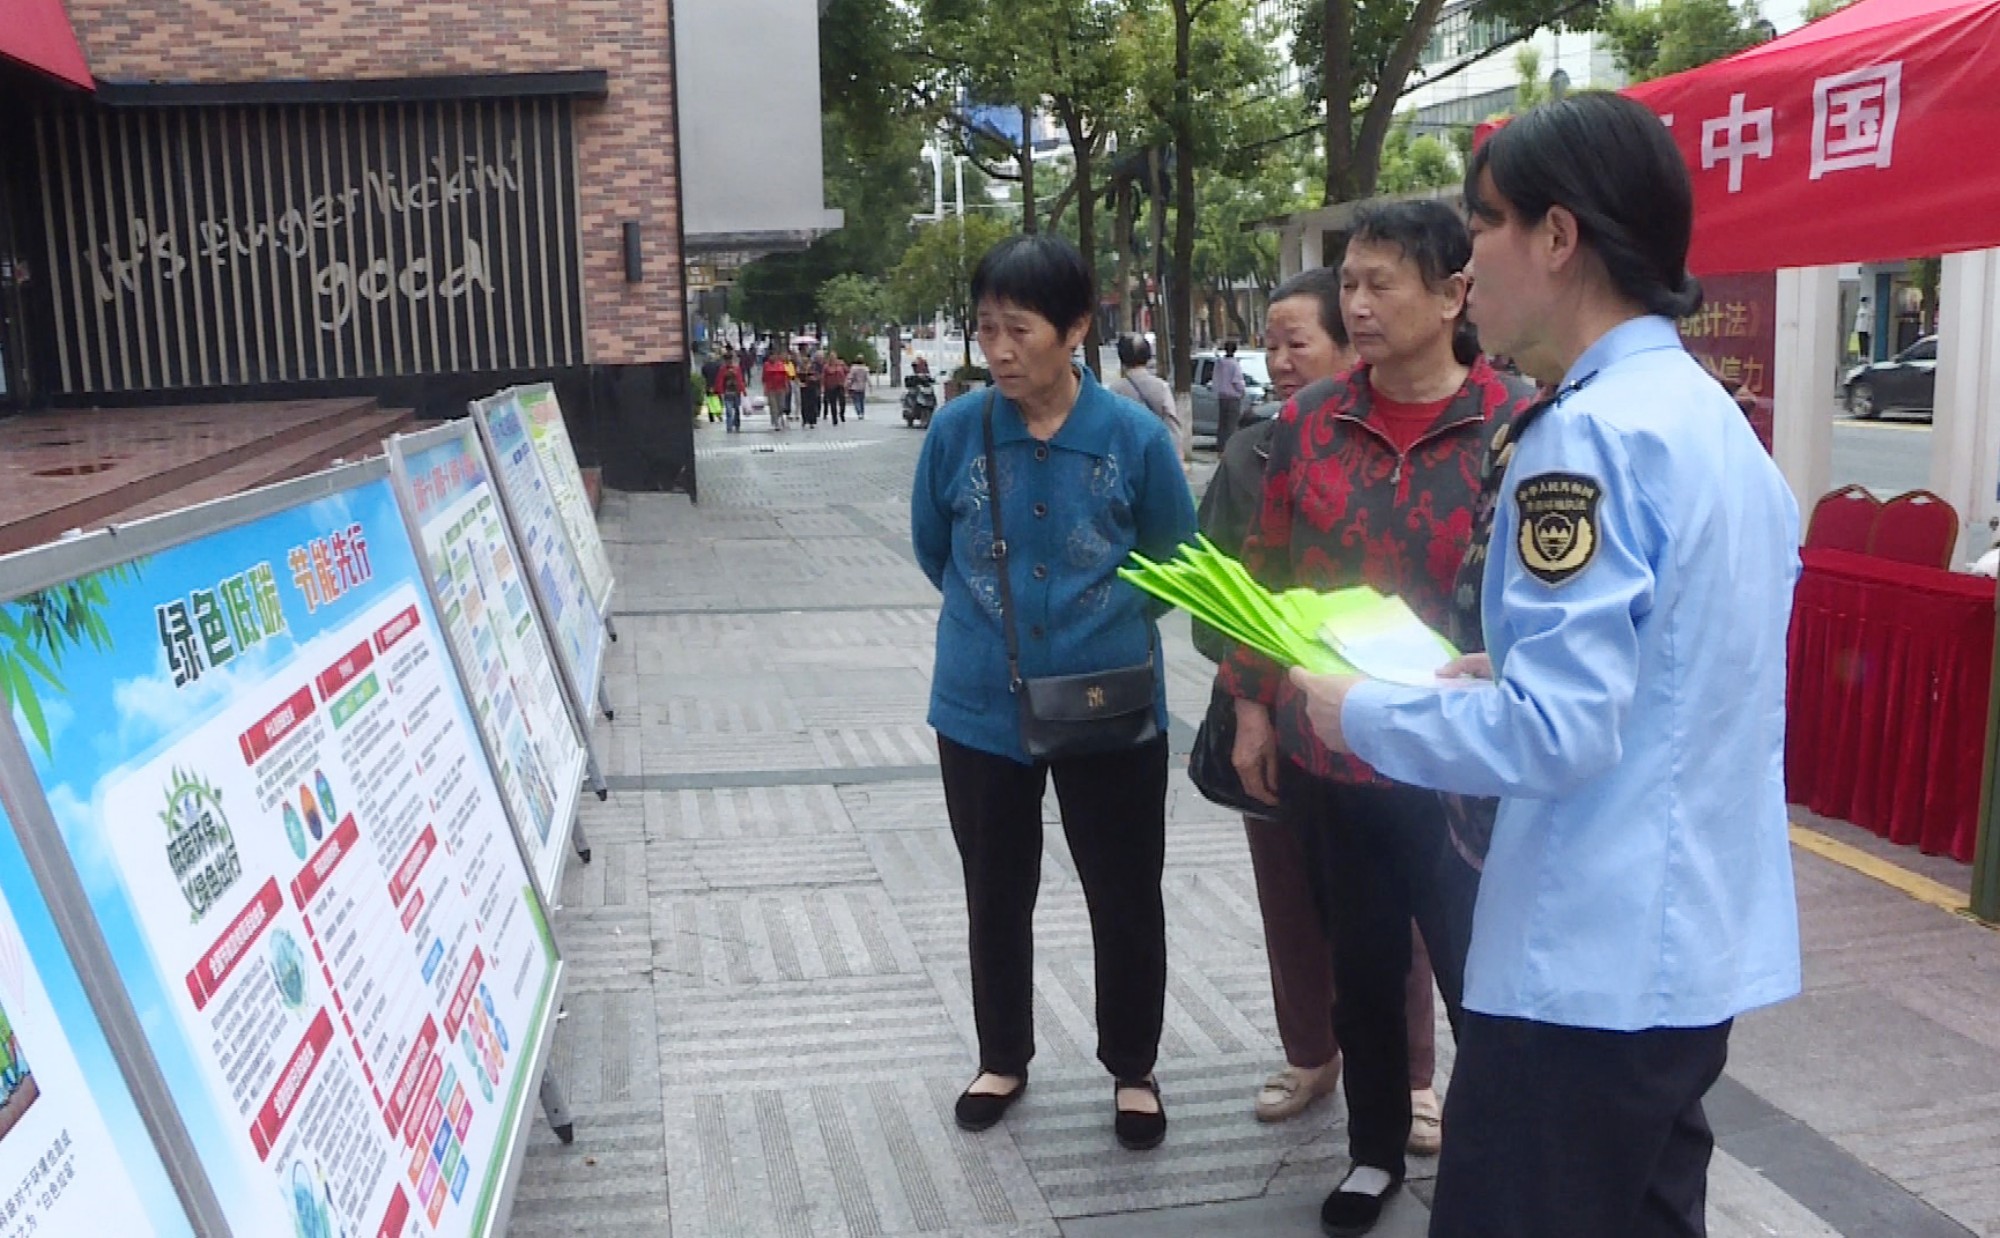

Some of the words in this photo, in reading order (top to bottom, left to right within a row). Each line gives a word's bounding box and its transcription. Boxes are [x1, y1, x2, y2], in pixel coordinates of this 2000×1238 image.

[1660, 61, 1902, 193] 中国
[200, 187, 360, 266] finger
[317, 238, 495, 331] good
[1706, 356, 1765, 394] 信力
[155, 560, 287, 689] 绿色低碳
[288, 522, 373, 615] 节能先行
